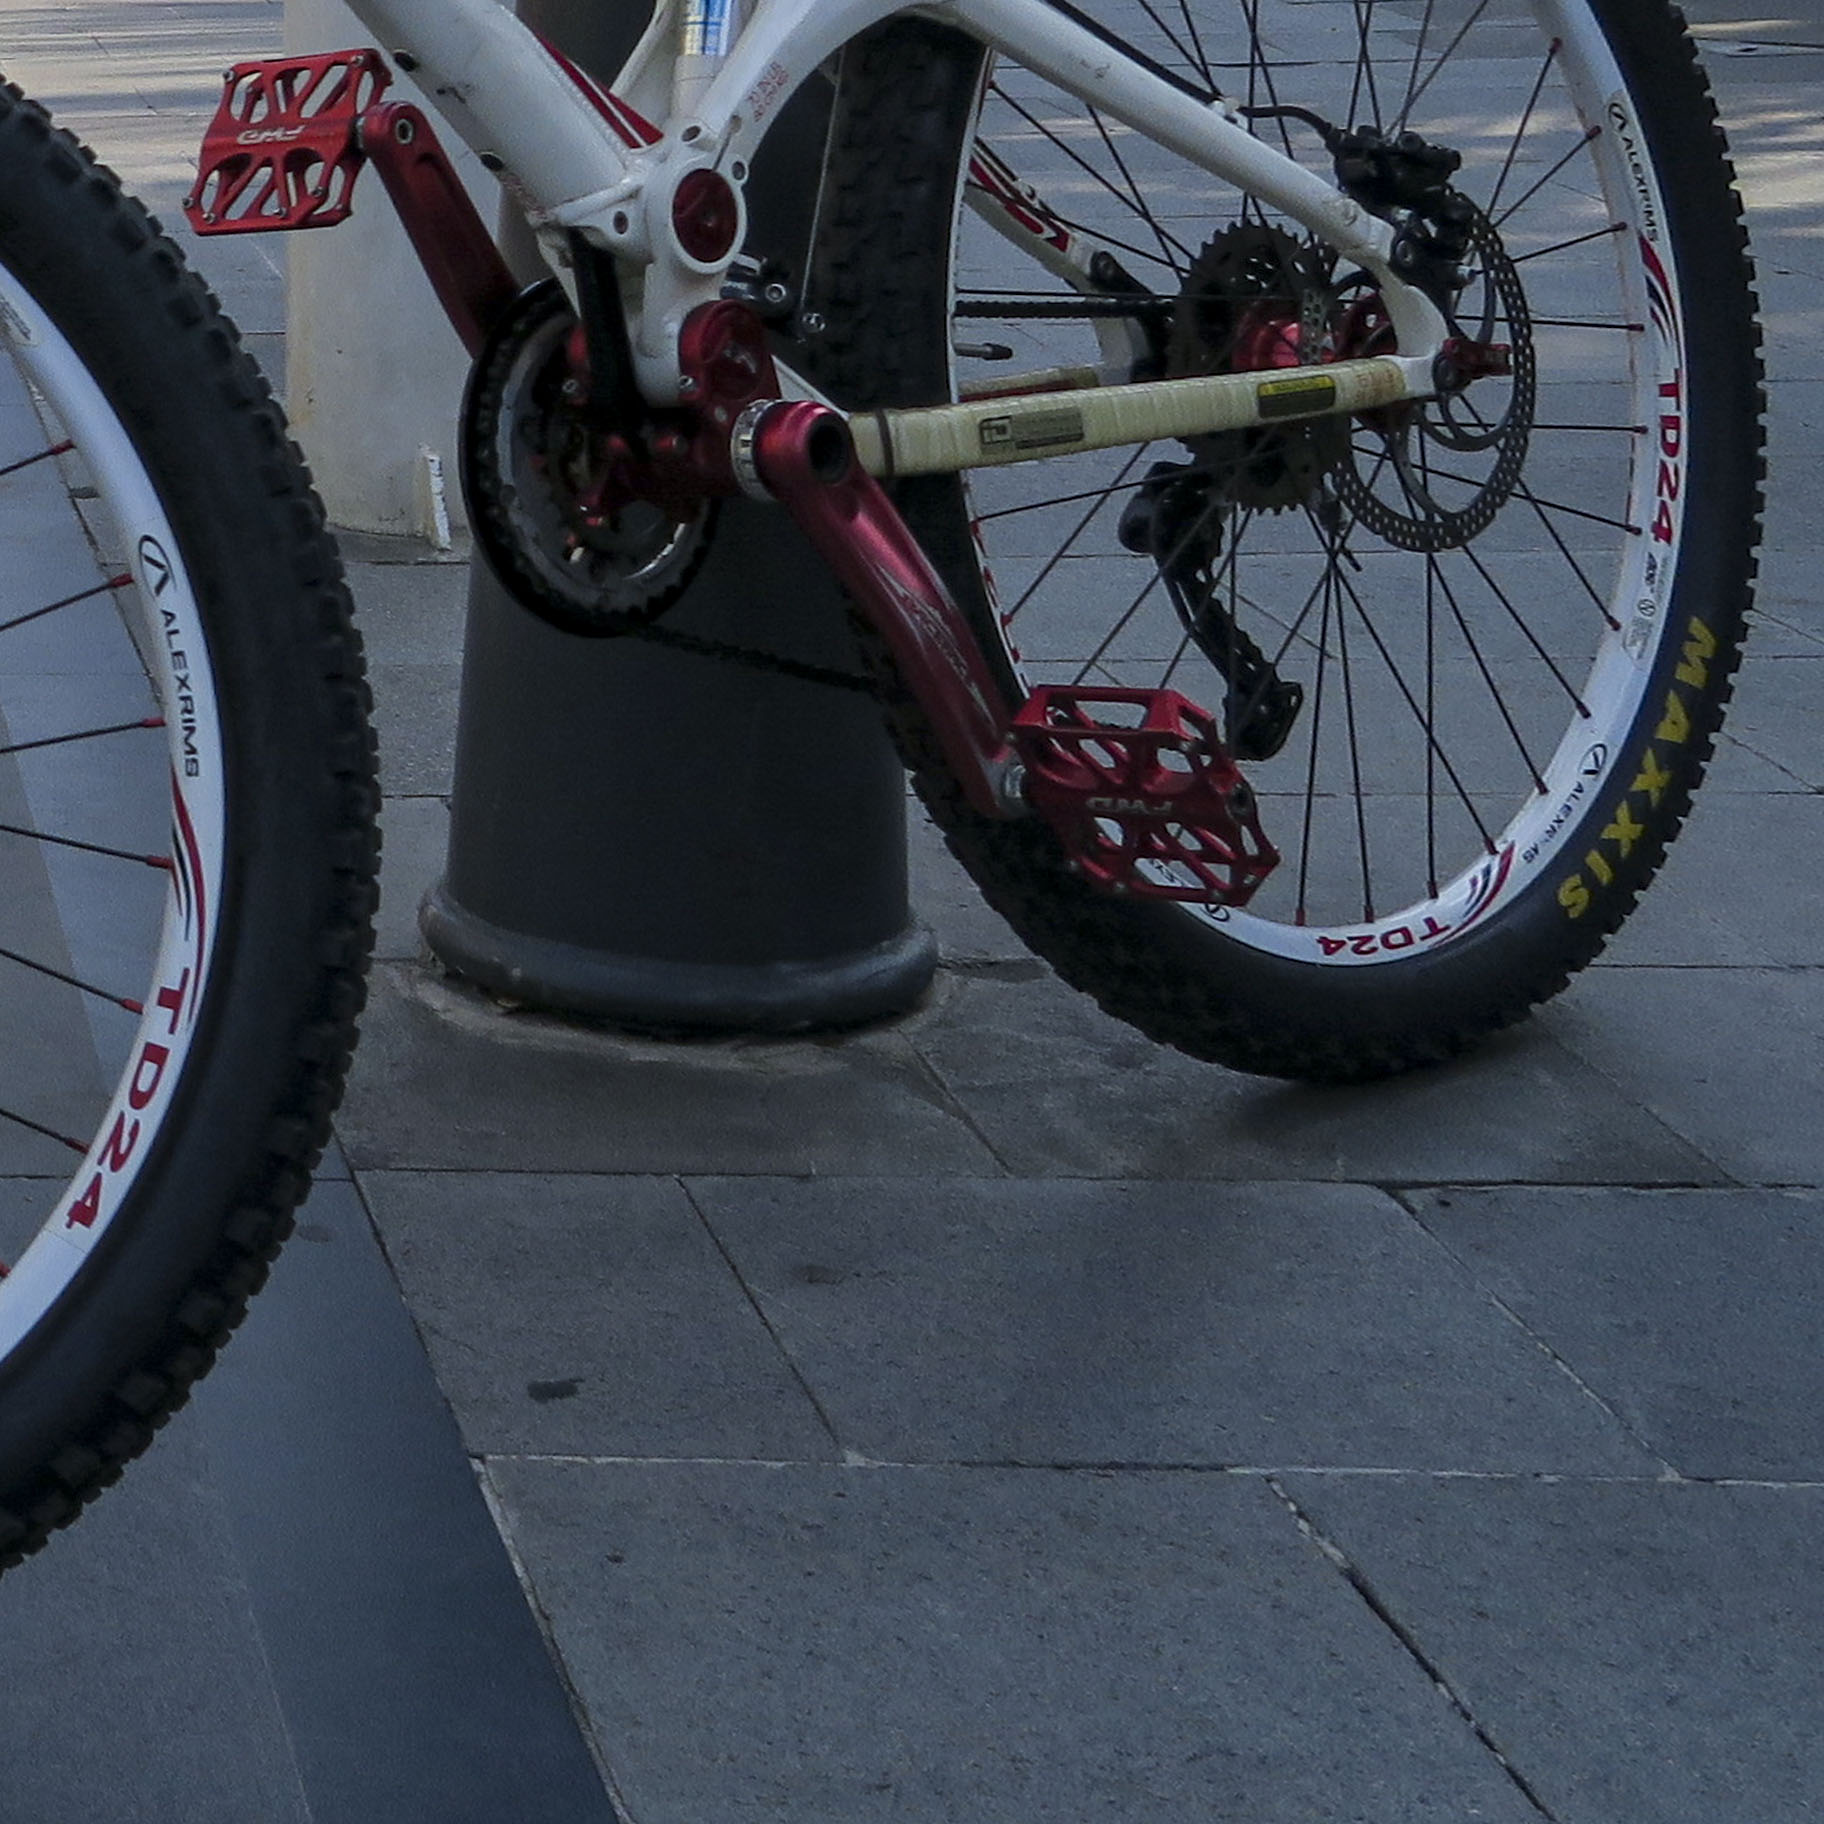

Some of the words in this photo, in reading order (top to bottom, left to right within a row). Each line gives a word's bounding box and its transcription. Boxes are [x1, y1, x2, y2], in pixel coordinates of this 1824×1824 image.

[1620, 135, 1658, 242] ALEXRIMS
[1652, 371, 1685, 546] TD24
[162, 608, 198, 776] ALEXRIMS
[1558, 616, 1718, 919] MAXXIS
[1315, 915, 1452, 956] TD24
[67, 967, 190, 1229] TD24
